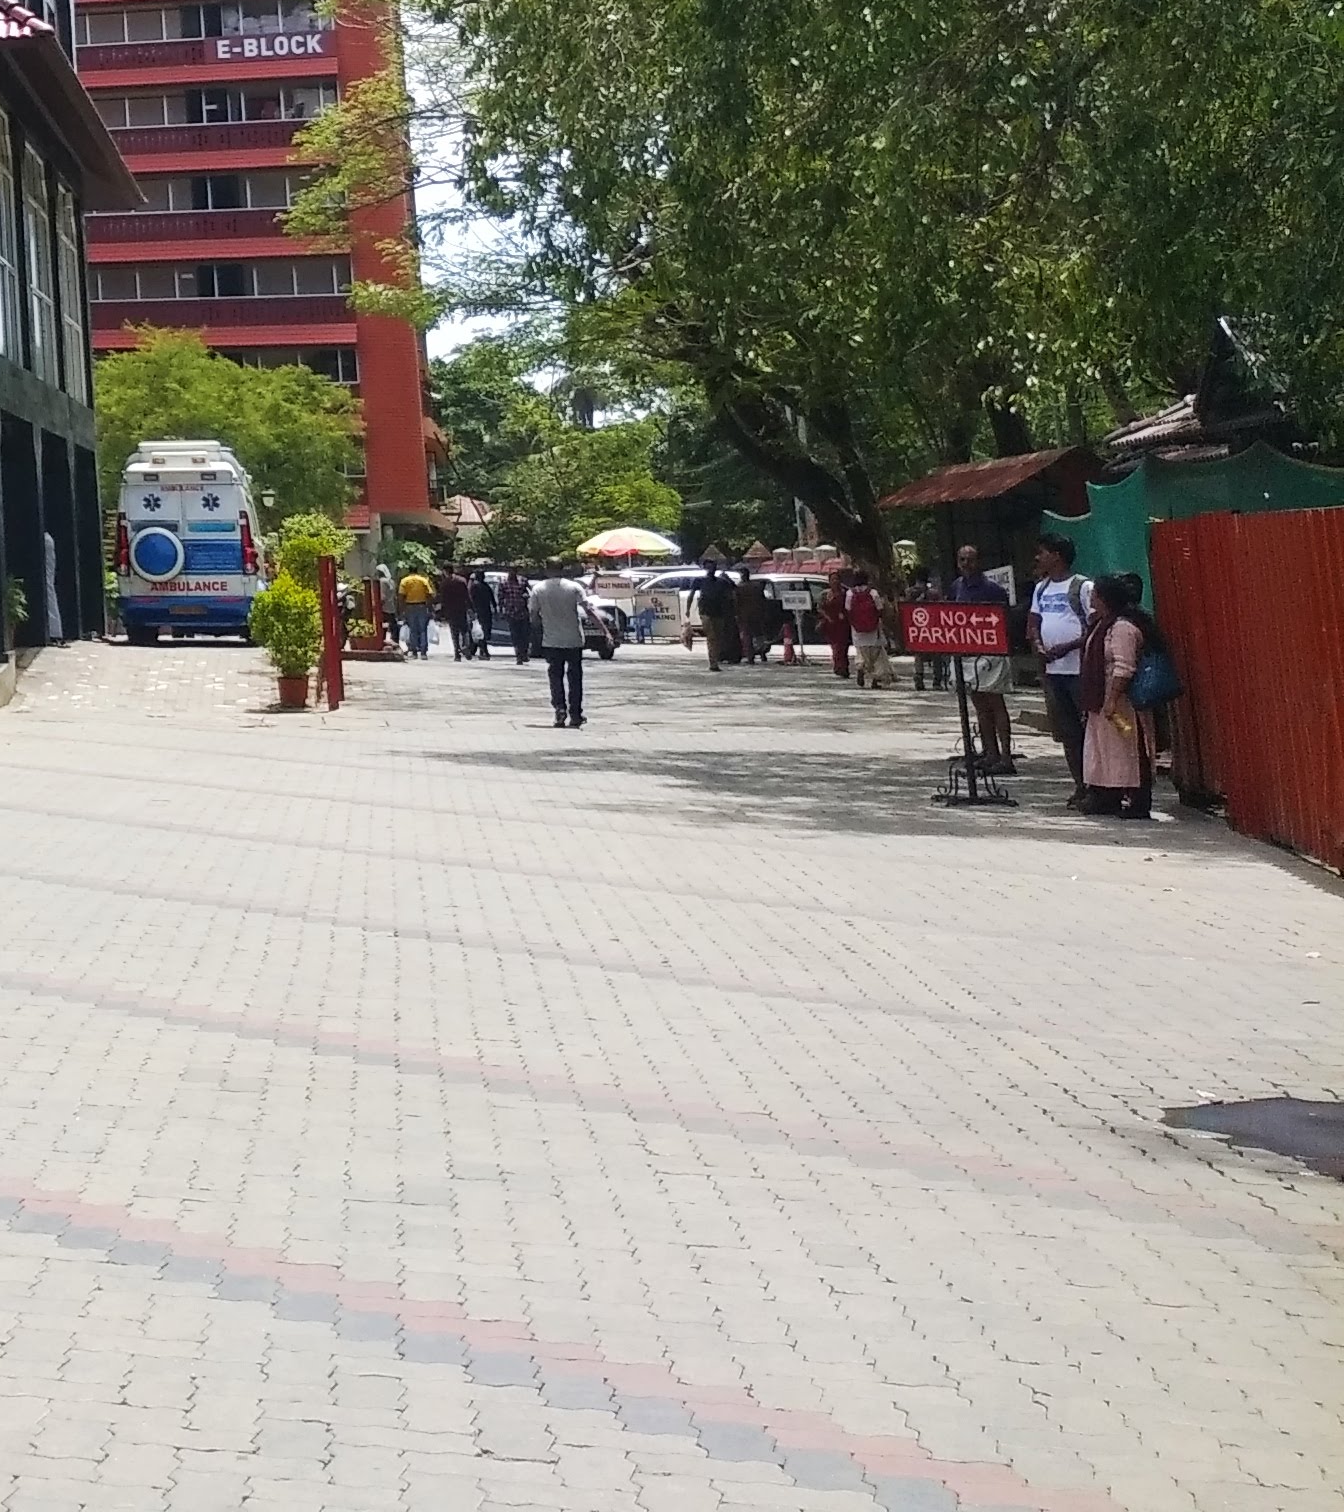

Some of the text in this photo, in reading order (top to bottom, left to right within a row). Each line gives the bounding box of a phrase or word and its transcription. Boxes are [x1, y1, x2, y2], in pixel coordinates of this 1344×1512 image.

[216, 33, 324, 59] E-BLOCK
[150, 580, 228, 592] AMBULANCE
[939, 610, 967, 626] NO
[908, 626, 998, 646] PARKING
